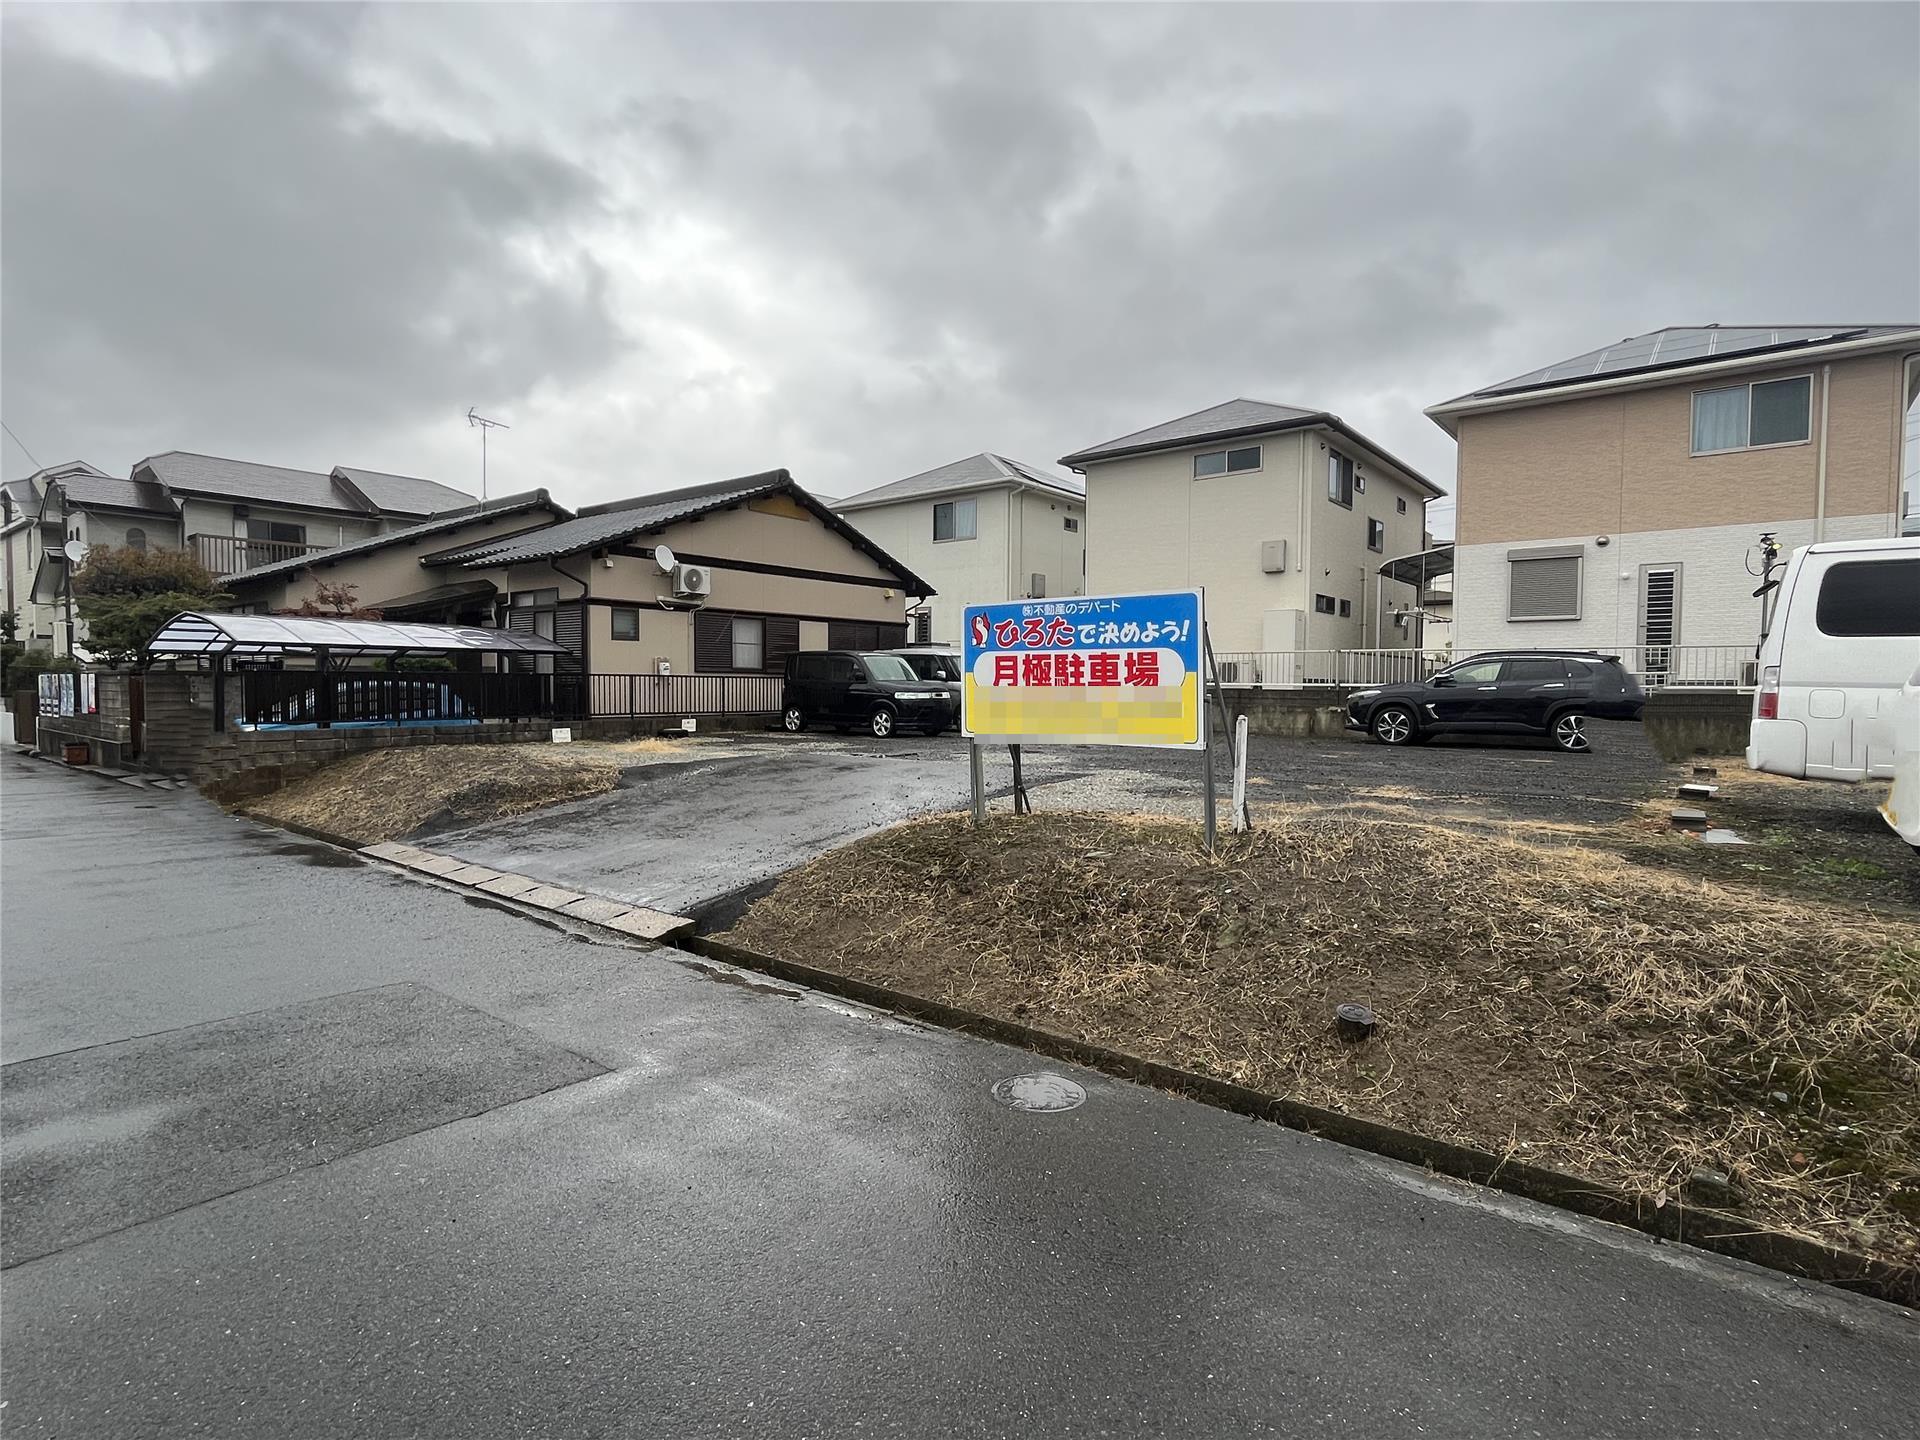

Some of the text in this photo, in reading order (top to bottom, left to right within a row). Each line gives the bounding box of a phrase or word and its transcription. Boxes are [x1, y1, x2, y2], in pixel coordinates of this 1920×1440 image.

[993, 652, 1160, 687] 月極駐車場
